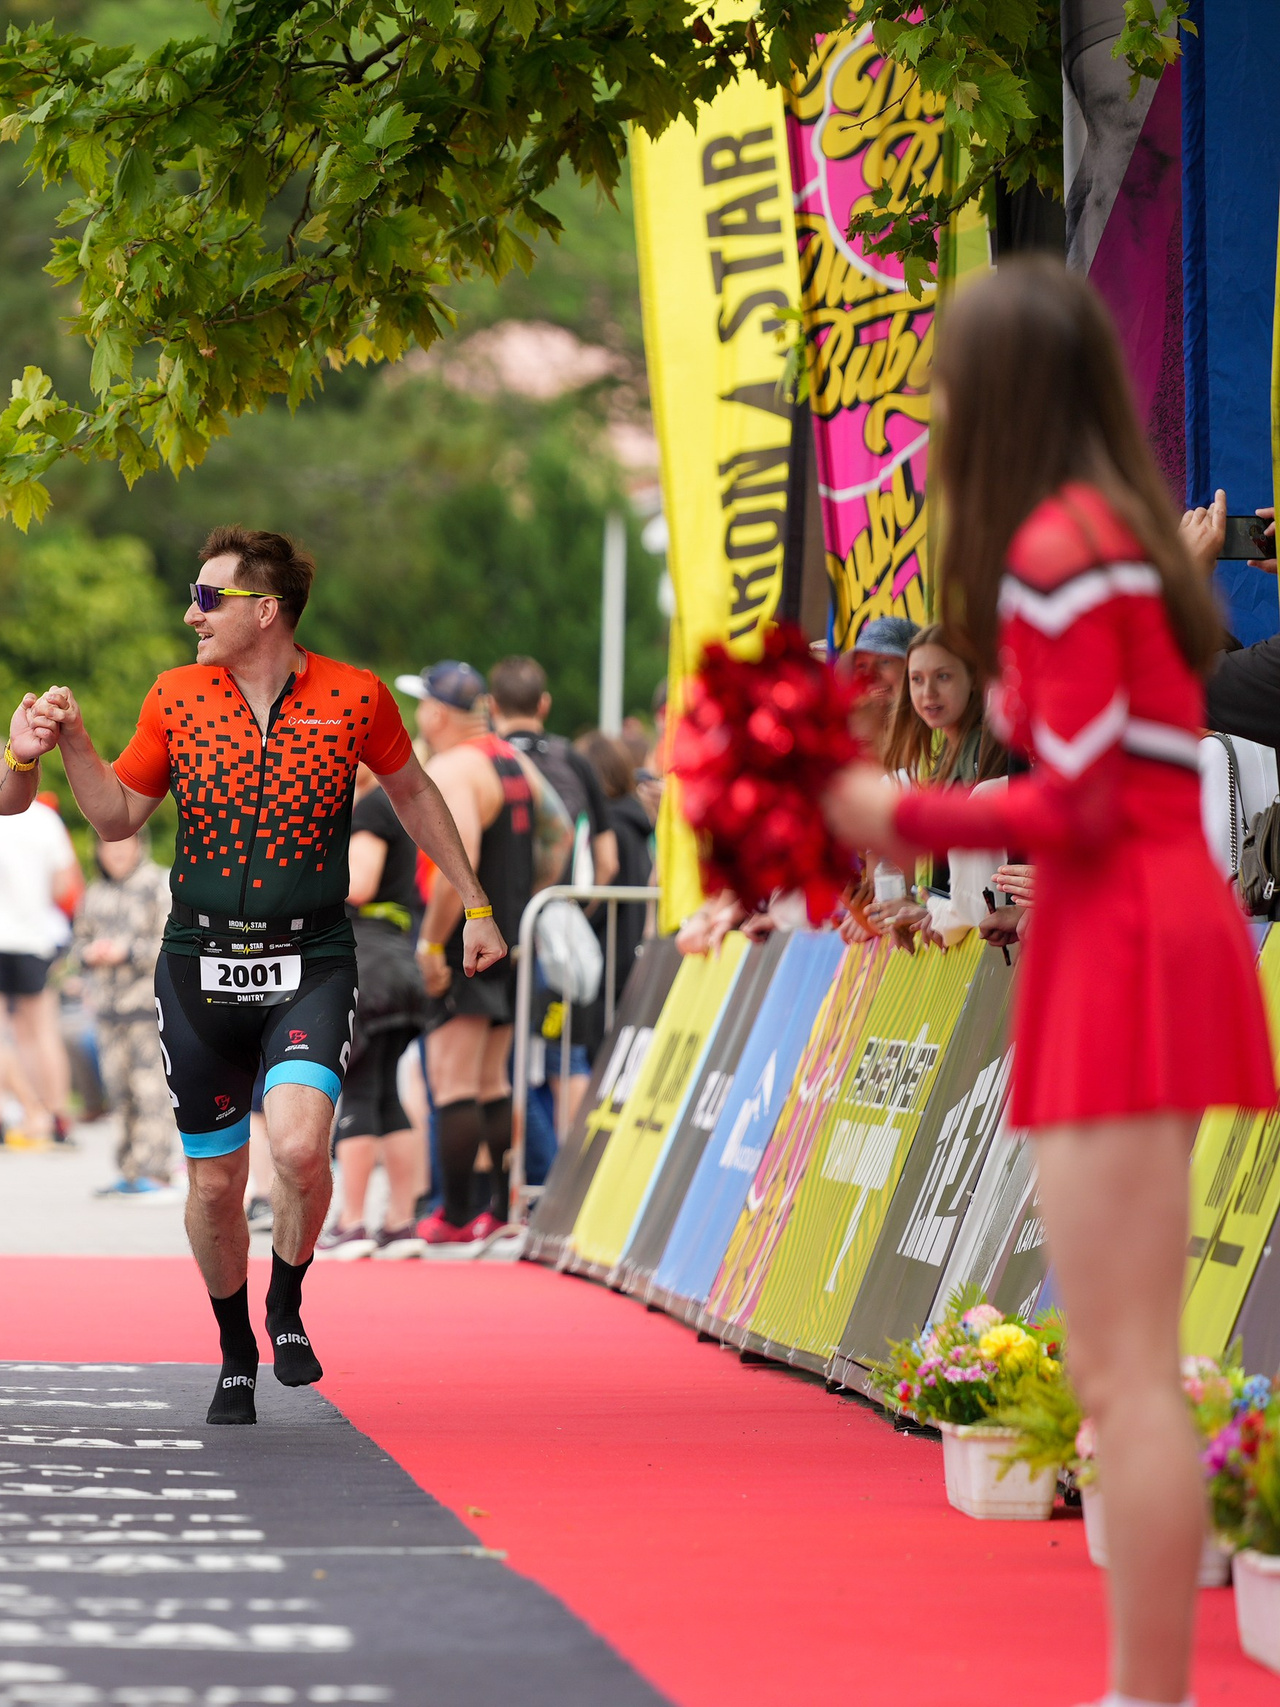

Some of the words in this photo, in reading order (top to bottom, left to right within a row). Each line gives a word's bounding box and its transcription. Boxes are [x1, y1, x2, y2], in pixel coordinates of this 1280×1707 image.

[701, 126, 791, 343] STAR
[228, 919, 244, 929] IRON
[250, 921, 267, 929] STAR
[231, 942, 245, 950] IRON
[249, 942, 263, 950] STAR
[217, 962, 282, 988] 2001
[237, 993, 265, 1002] DMITRY
[896, 1041, 1016, 1267] TELE2
[276, 1333, 309, 1346] GIRO
[222, 1375, 255, 1389] GIRO
